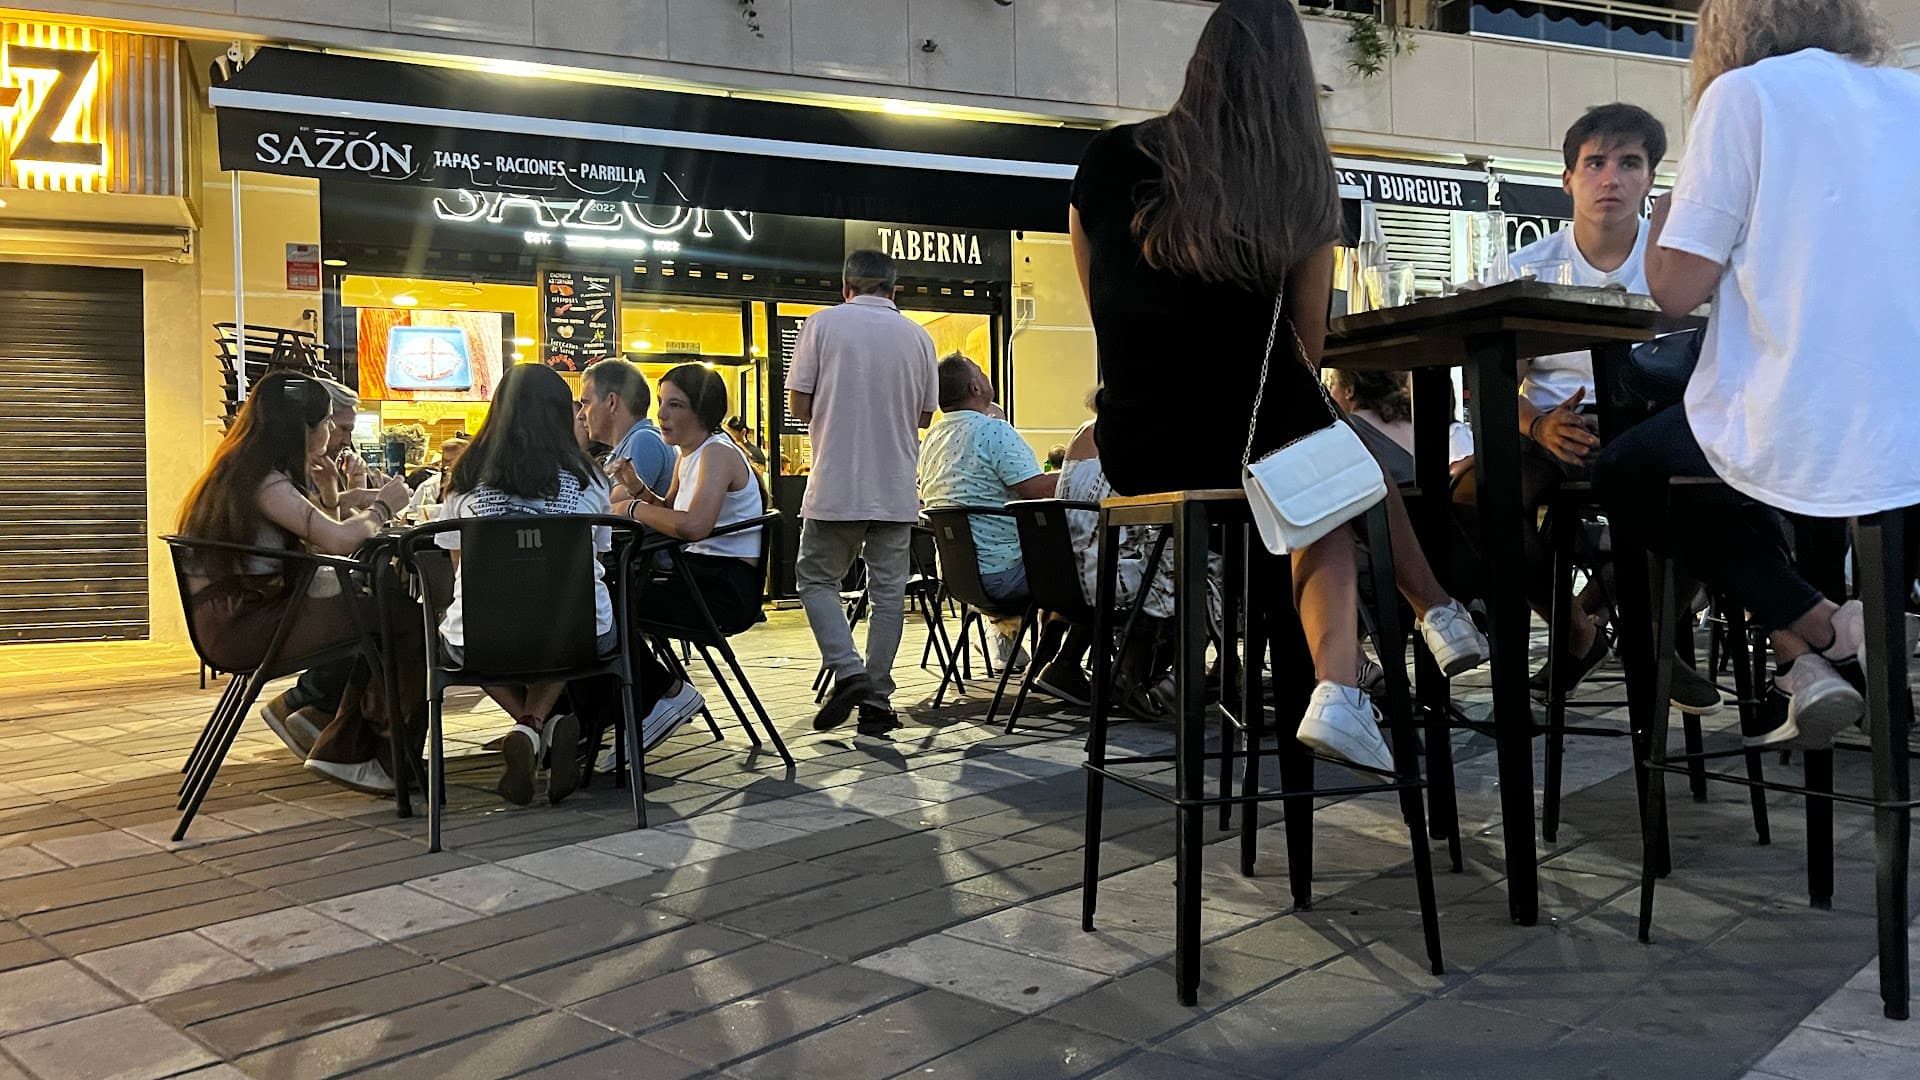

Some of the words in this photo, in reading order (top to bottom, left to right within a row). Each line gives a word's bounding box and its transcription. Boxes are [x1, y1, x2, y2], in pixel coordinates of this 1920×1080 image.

[255, 130, 413, 174] SAZÓN
[434, 151, 480, 170] TAPAS
[496, 156, 565, 176] RACIONES
[580, 163, 646, 183] PARRILLA
[1360, 173, 1372, 198] Y
[1377, 174, 1464, 207] BURGUER
[877, 227, 982, 265] TABERNA
